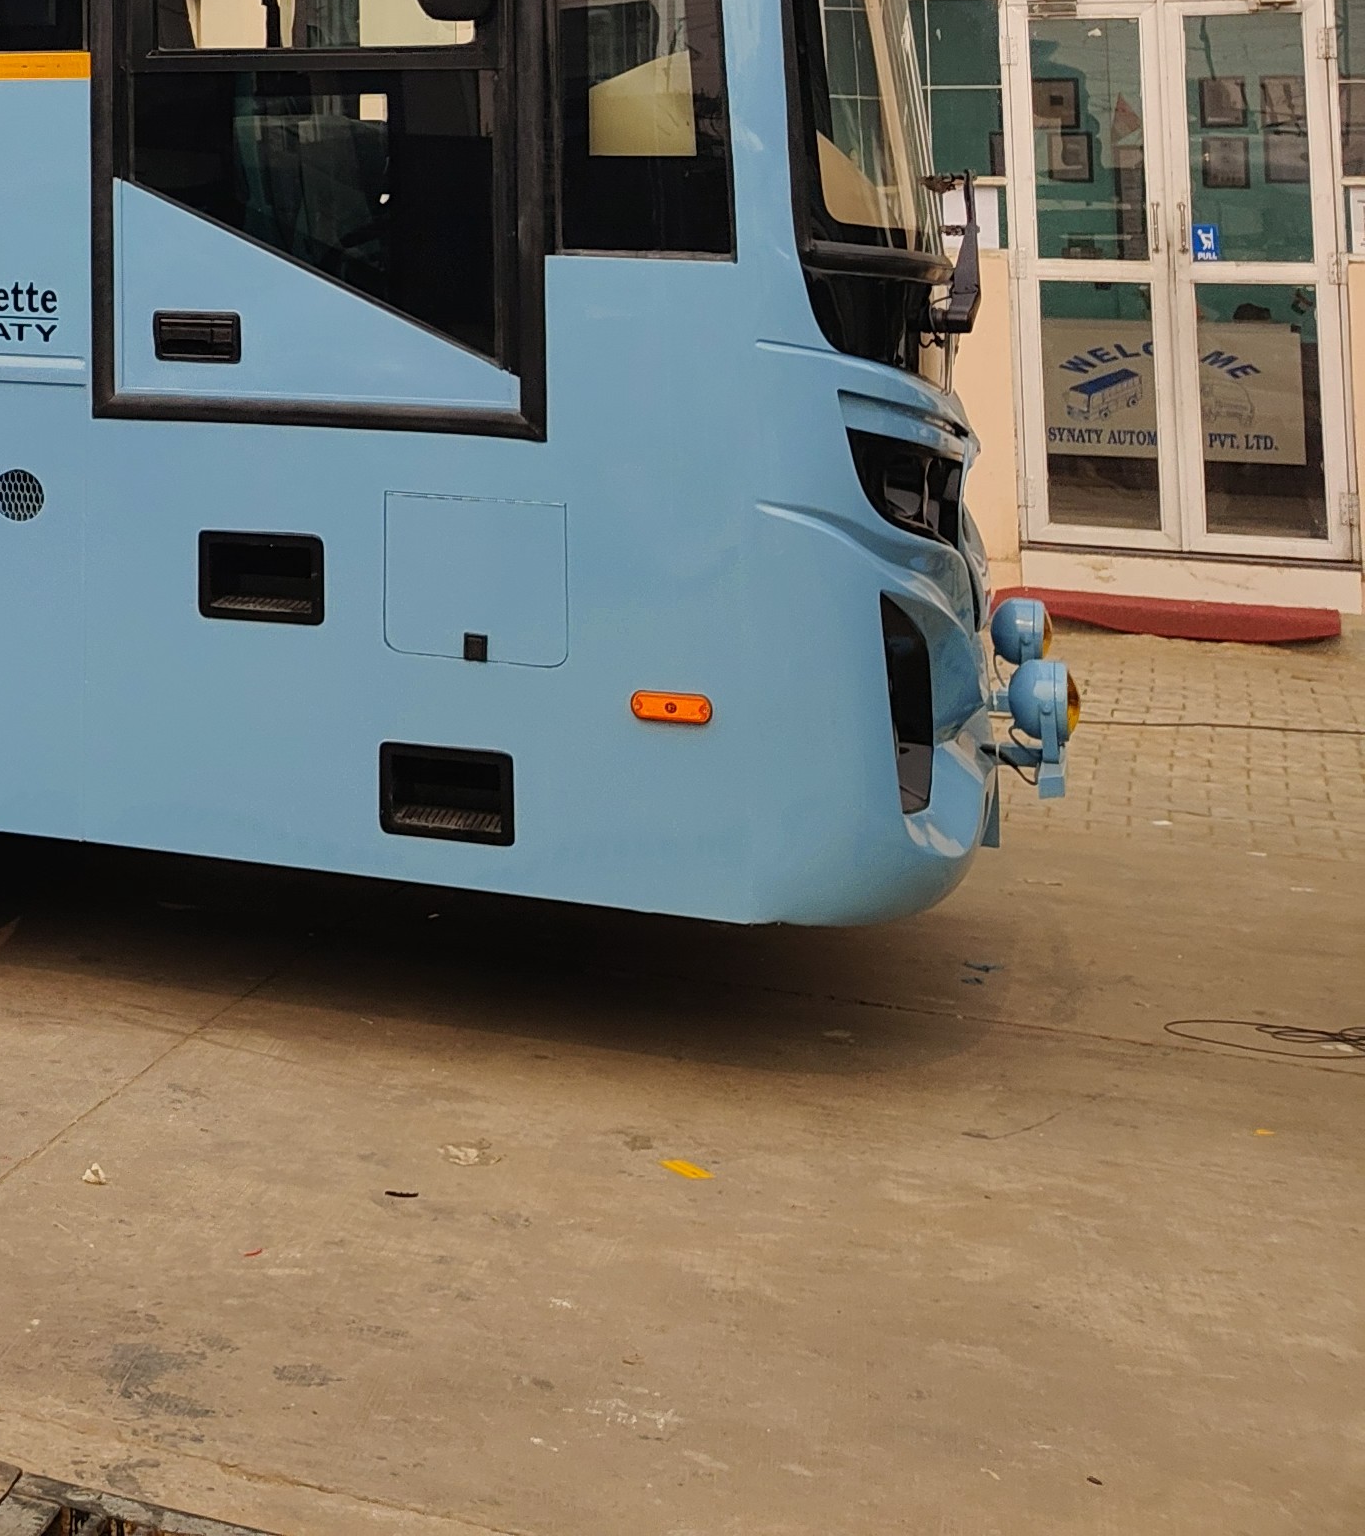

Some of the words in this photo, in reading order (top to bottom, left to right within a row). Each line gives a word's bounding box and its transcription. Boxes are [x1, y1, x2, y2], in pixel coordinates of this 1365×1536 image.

[1197, 251, 1218, 261] PULL
[1048, 426, 1103, 445] SYNATY
[1207, 432, 1240, 451] PVT.
[1244, 434, 1279, 452] LTD.
